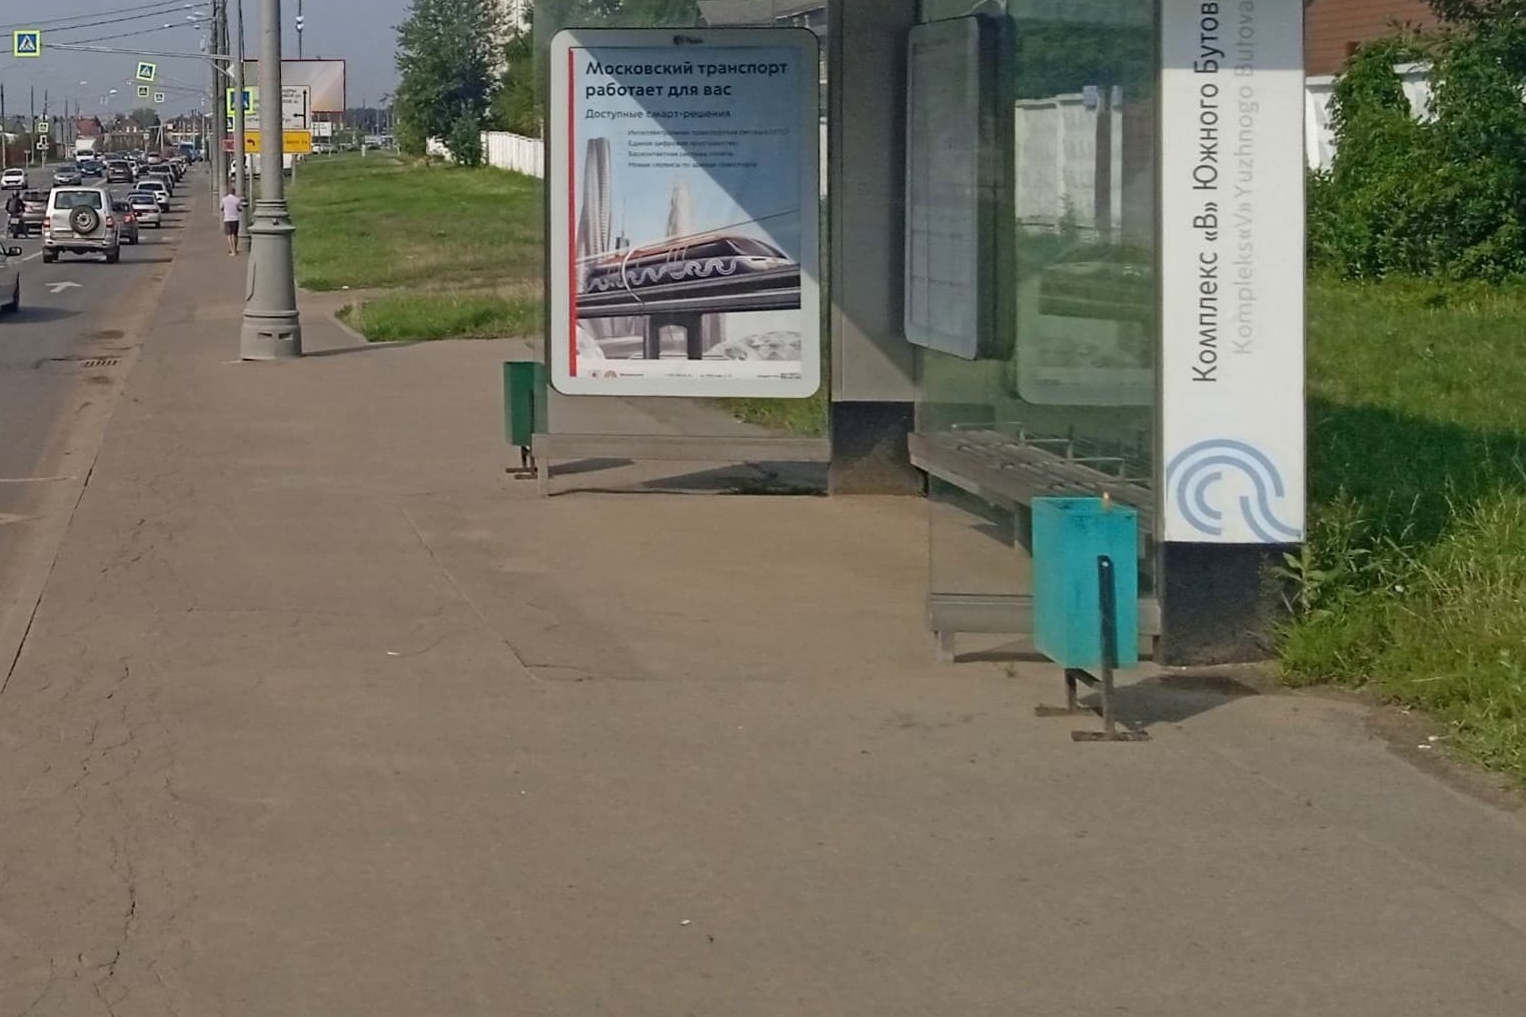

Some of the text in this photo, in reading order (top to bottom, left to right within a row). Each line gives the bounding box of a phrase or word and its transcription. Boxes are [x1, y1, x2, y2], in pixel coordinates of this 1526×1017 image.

[585, 62, 788, 76] Московский транспорт
[1233, 0, 1255, 78] Butova
[585, 82, 732, 99] работает для вас
[585, 109, 732, 120] Доступные смарт-решения
[1192, 83, 1219, 190] Южного
[1233, 85, 1259, 198] Yuzhnogo
[1193, 201, 1218, 242] «В»
[1192, 252, 1218, 382] Комплекс
[1232, 241, 1256, 355] Kompleks
